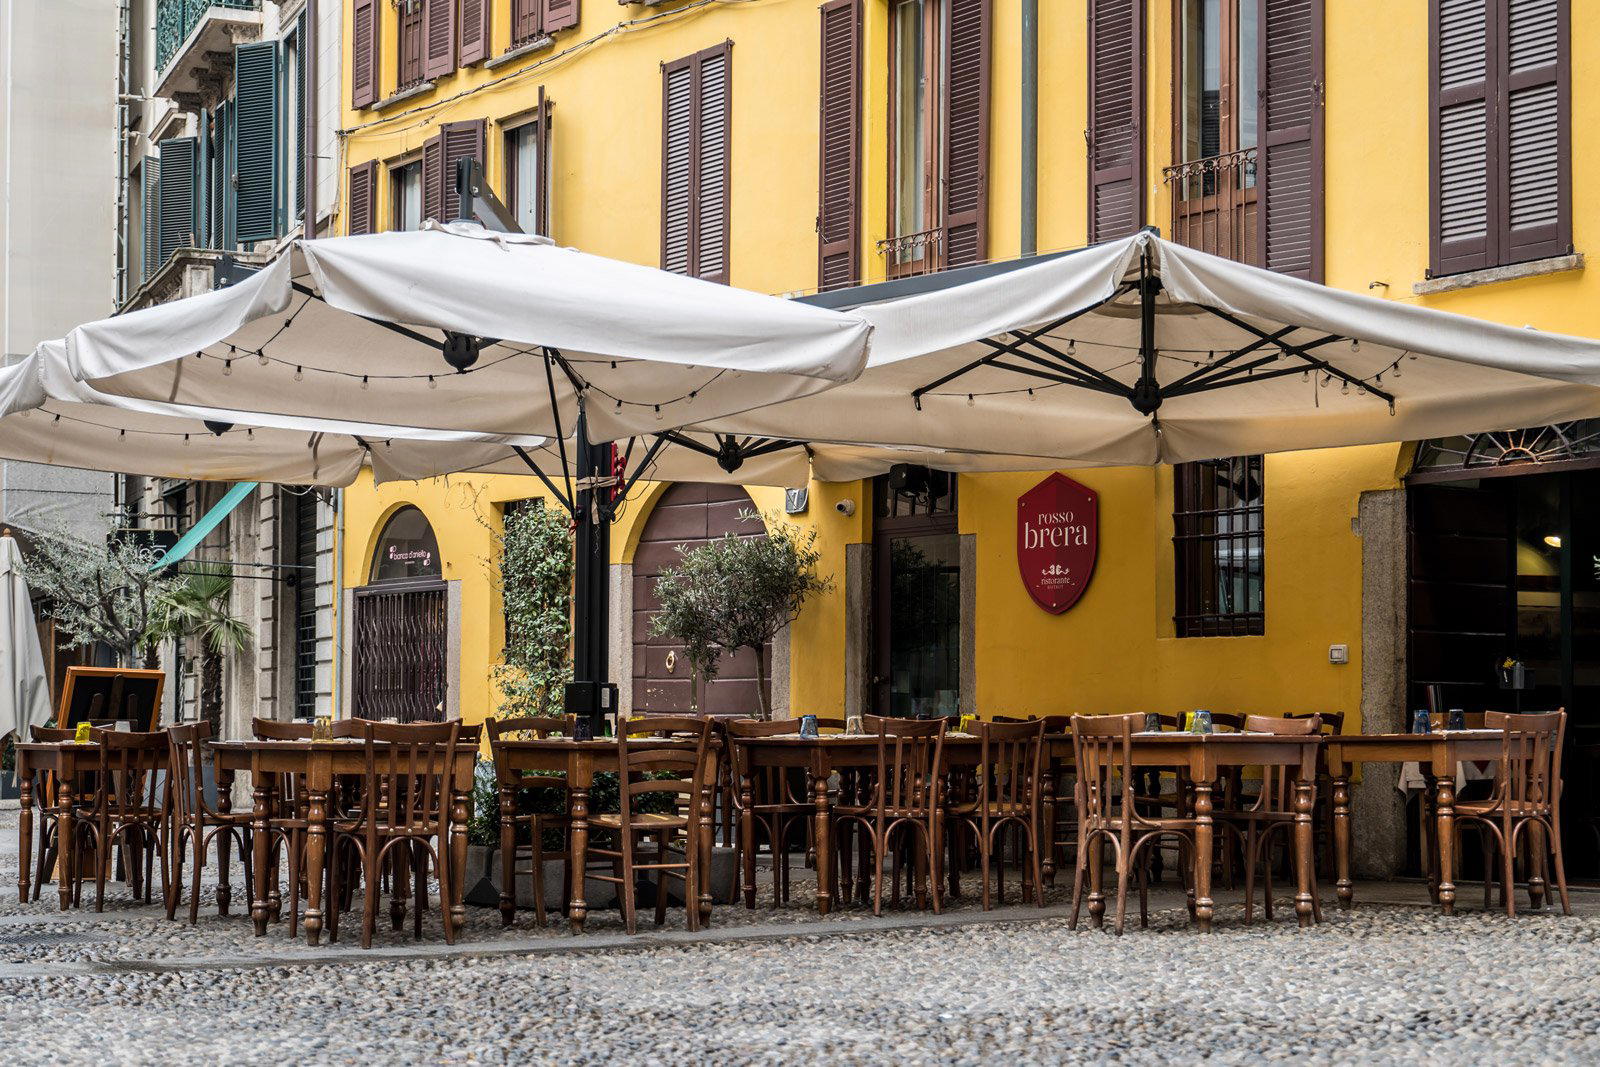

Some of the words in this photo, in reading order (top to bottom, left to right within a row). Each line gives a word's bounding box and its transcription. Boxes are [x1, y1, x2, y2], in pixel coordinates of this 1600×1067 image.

[1038, 511, 1074, 525] rosso
[1024, 521, 1088, 549] brera
[1041, 577, 1071, 585] ristorante
